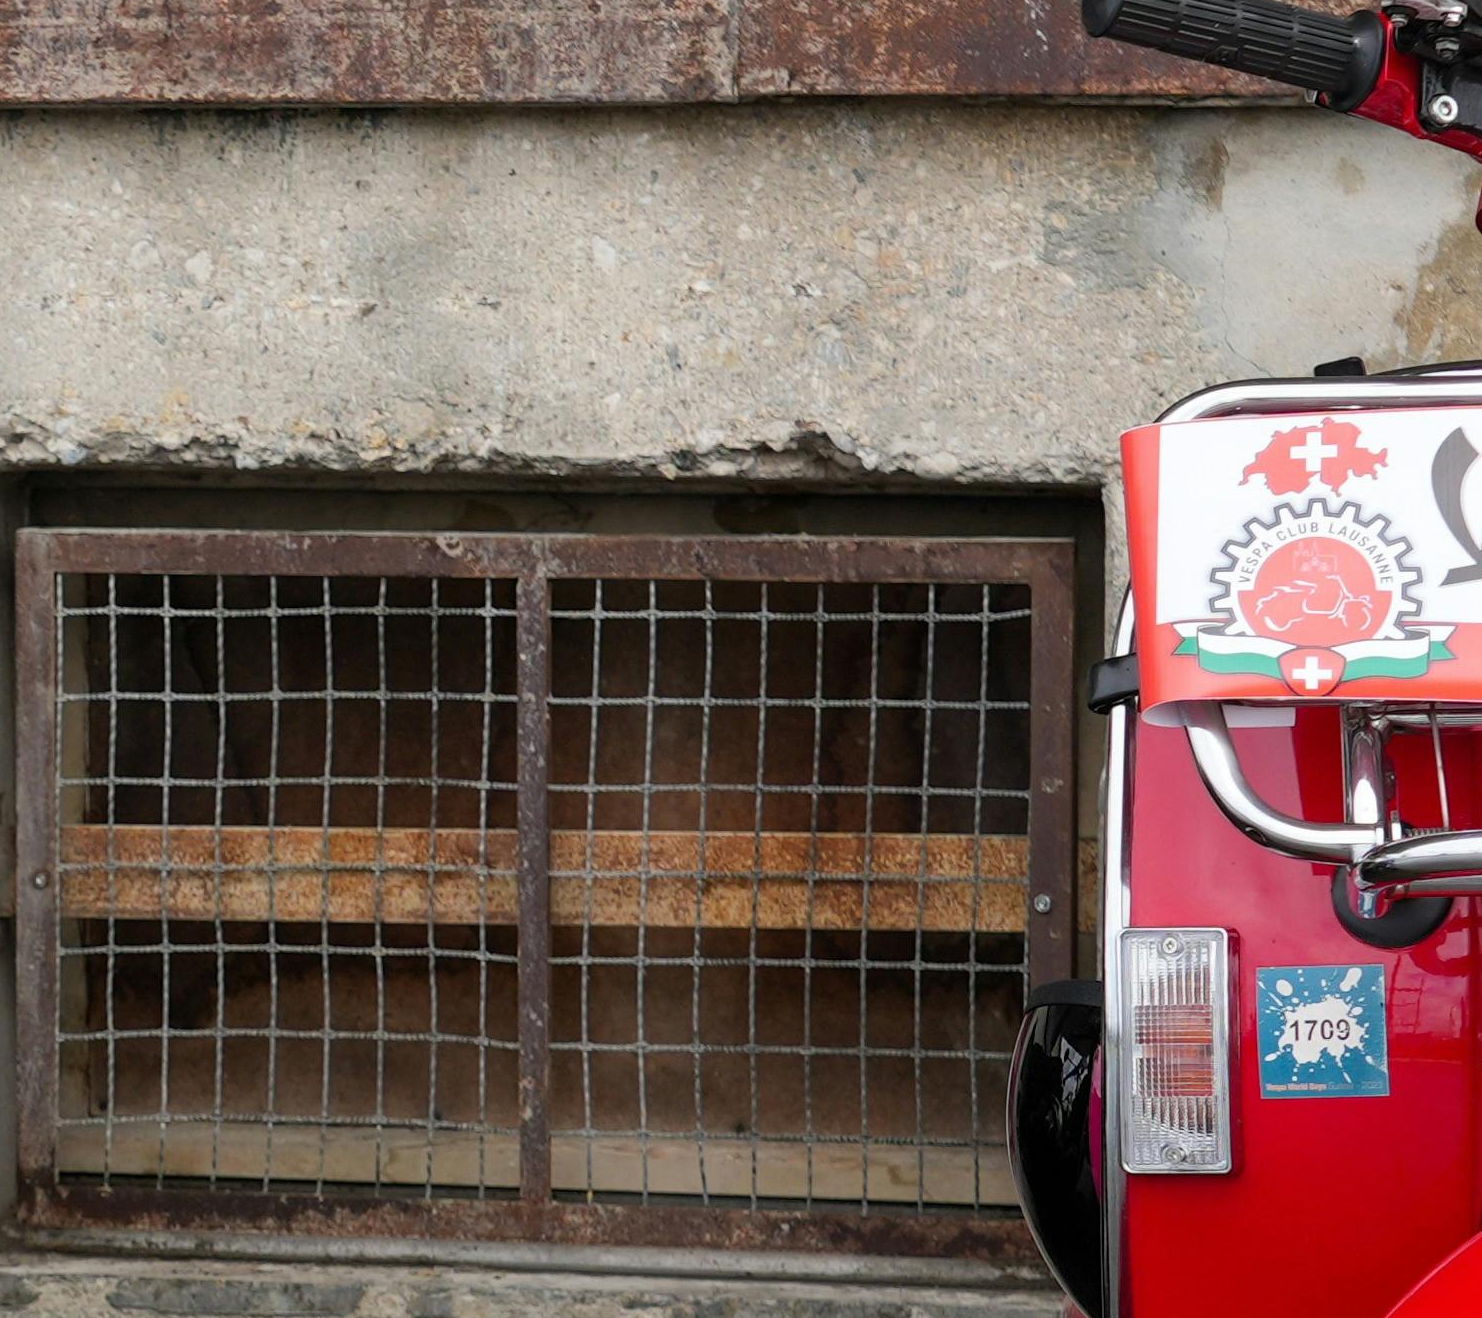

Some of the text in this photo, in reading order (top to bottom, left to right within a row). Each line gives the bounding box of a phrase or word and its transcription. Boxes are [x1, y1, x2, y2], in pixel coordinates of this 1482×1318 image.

[1238, 522, 1394, 584] VESPA CLUB LAUSANNE
[1289, 1019, 1351, 1041] 1709
